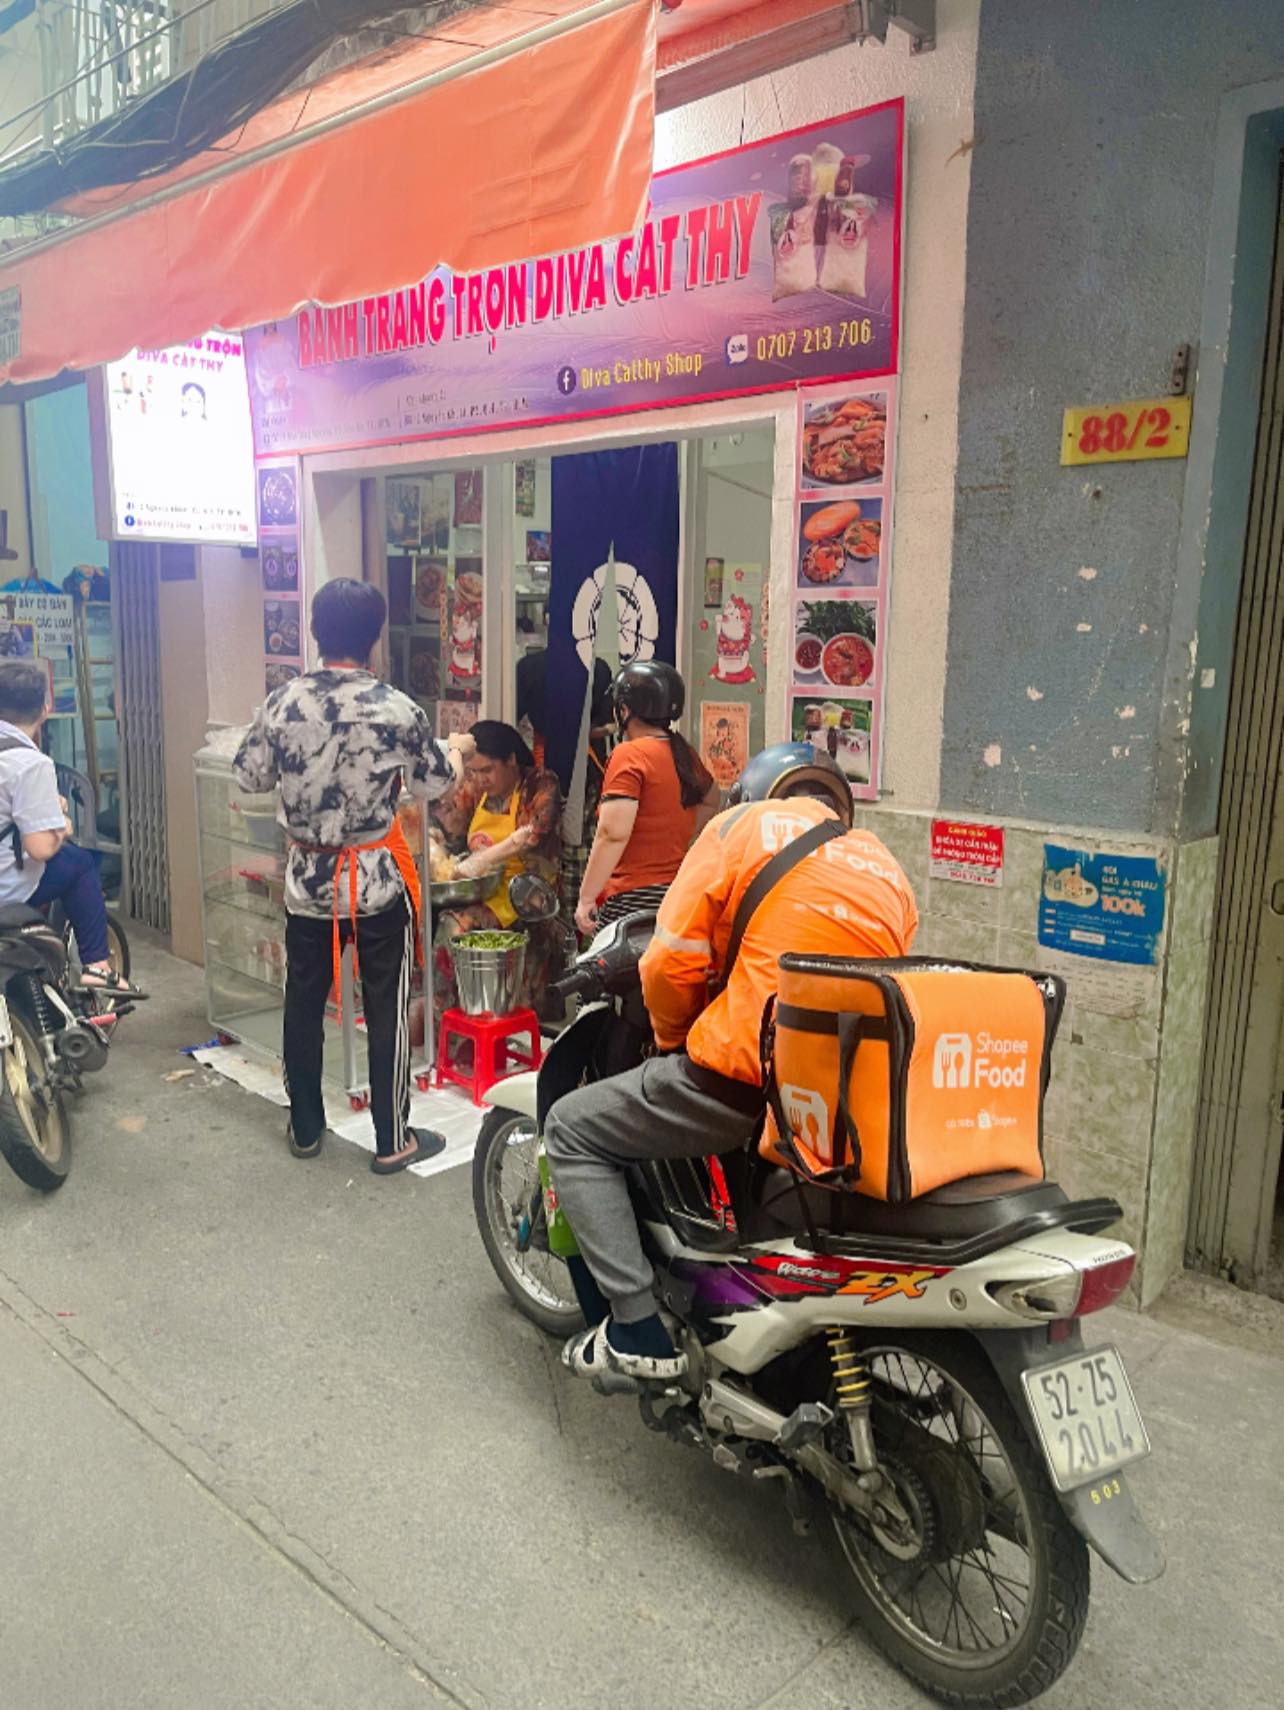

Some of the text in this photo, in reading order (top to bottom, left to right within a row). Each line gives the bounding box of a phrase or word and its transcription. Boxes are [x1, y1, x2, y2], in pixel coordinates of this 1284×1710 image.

[532, 244, 607, 323] DIVA
[685, 191, 763, 290] THY
[757, 334, 797, 361] 0707
[803, 328, 832, 354] 213
[838, 319, 873, 348] 706
[580, 366, 611, 390] Diva
[666, 352, 703, 376] Shop
[1079, 408, 1171, 455] 88/2
[976, 1031, 1028, 1059] Shopee
[974, 1058, 1027, 1088] Food
[836, 1270, 935, 1305] ZX
